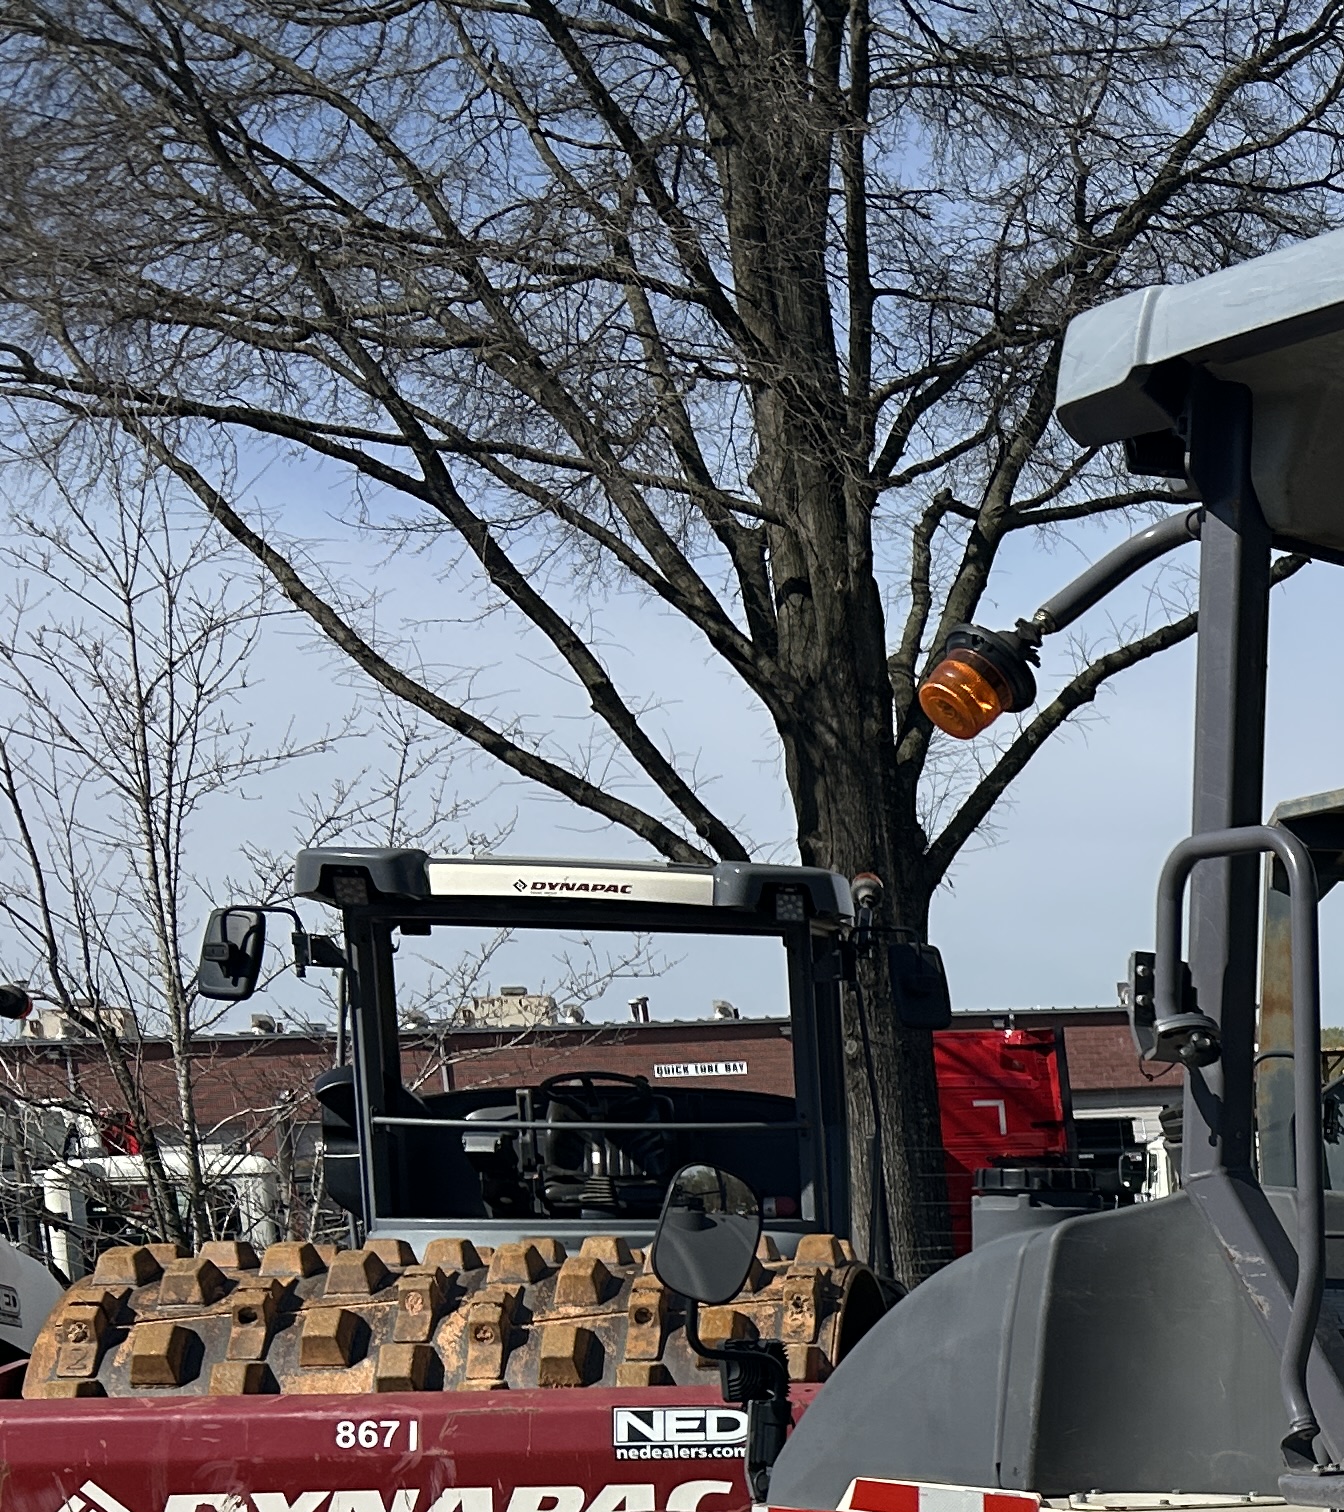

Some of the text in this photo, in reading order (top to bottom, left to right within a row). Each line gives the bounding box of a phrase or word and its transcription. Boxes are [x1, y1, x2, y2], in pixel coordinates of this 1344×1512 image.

[530, 881, 634, 894] DYNAPAC
[615, 1408, 749, 1443] NED
[616, 1444, 746, 1460] nedealers.com
